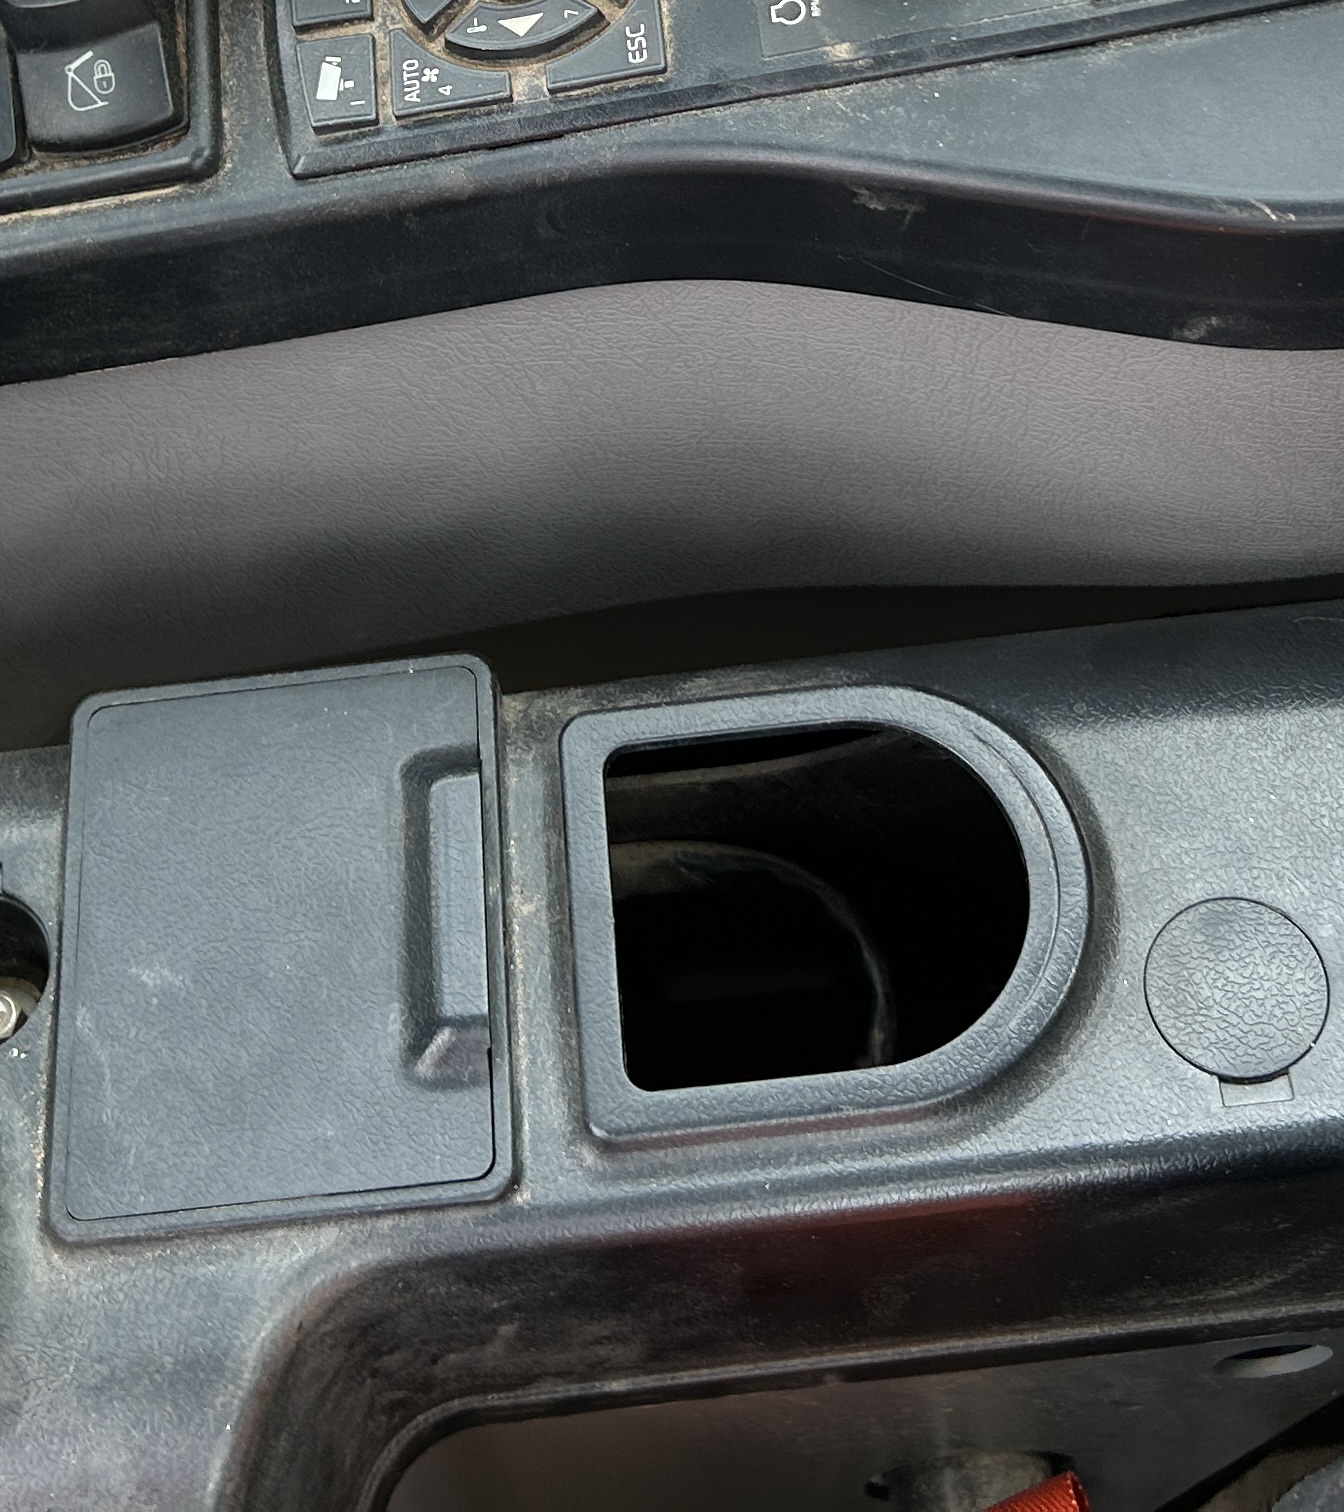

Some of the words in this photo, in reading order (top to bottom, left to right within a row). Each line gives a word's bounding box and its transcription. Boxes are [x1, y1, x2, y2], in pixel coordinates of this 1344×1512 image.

[563, 9, 580, 19] 7
[625, 24, 649, 64] ESC
[402, 59, 421, 103] AUTO
[438, 84, 453, 96] 4
